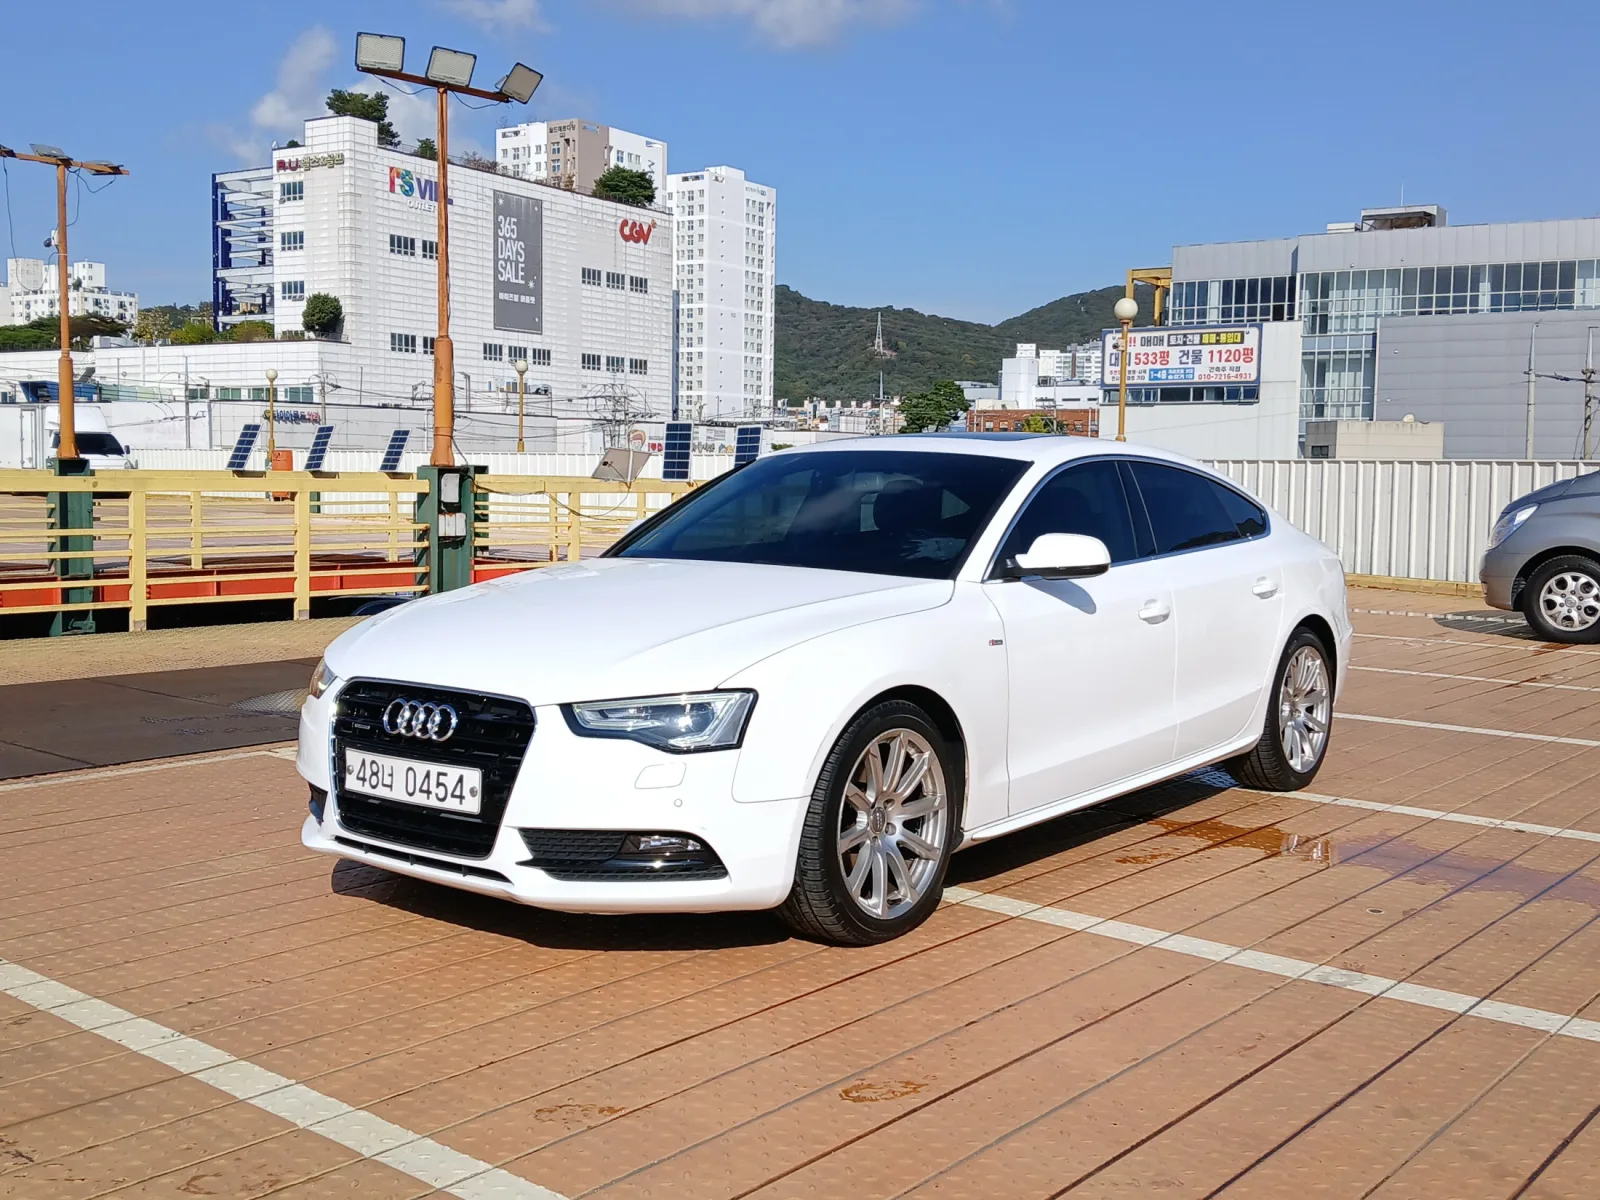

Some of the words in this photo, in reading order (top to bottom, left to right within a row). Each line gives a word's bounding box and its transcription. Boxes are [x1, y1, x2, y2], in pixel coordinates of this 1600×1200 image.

[408, 200, 436, 213] OUTLET
[498, 215, 518, 239] 365
[619, 218, 652, 245] CGV
[498, 237, 525, 262] DAYS
[498, 260, 525, 284] SALE
[1140, 335, 1165, 347] 매매
[1134, 350, 1170, 366] 533평
[1178, 349, 1203, 365] 건물
[1208, 347, 1254, 364] 1120평
[356, 758, 394, 791] 48너
[405, 766, 466, 805] 0454
